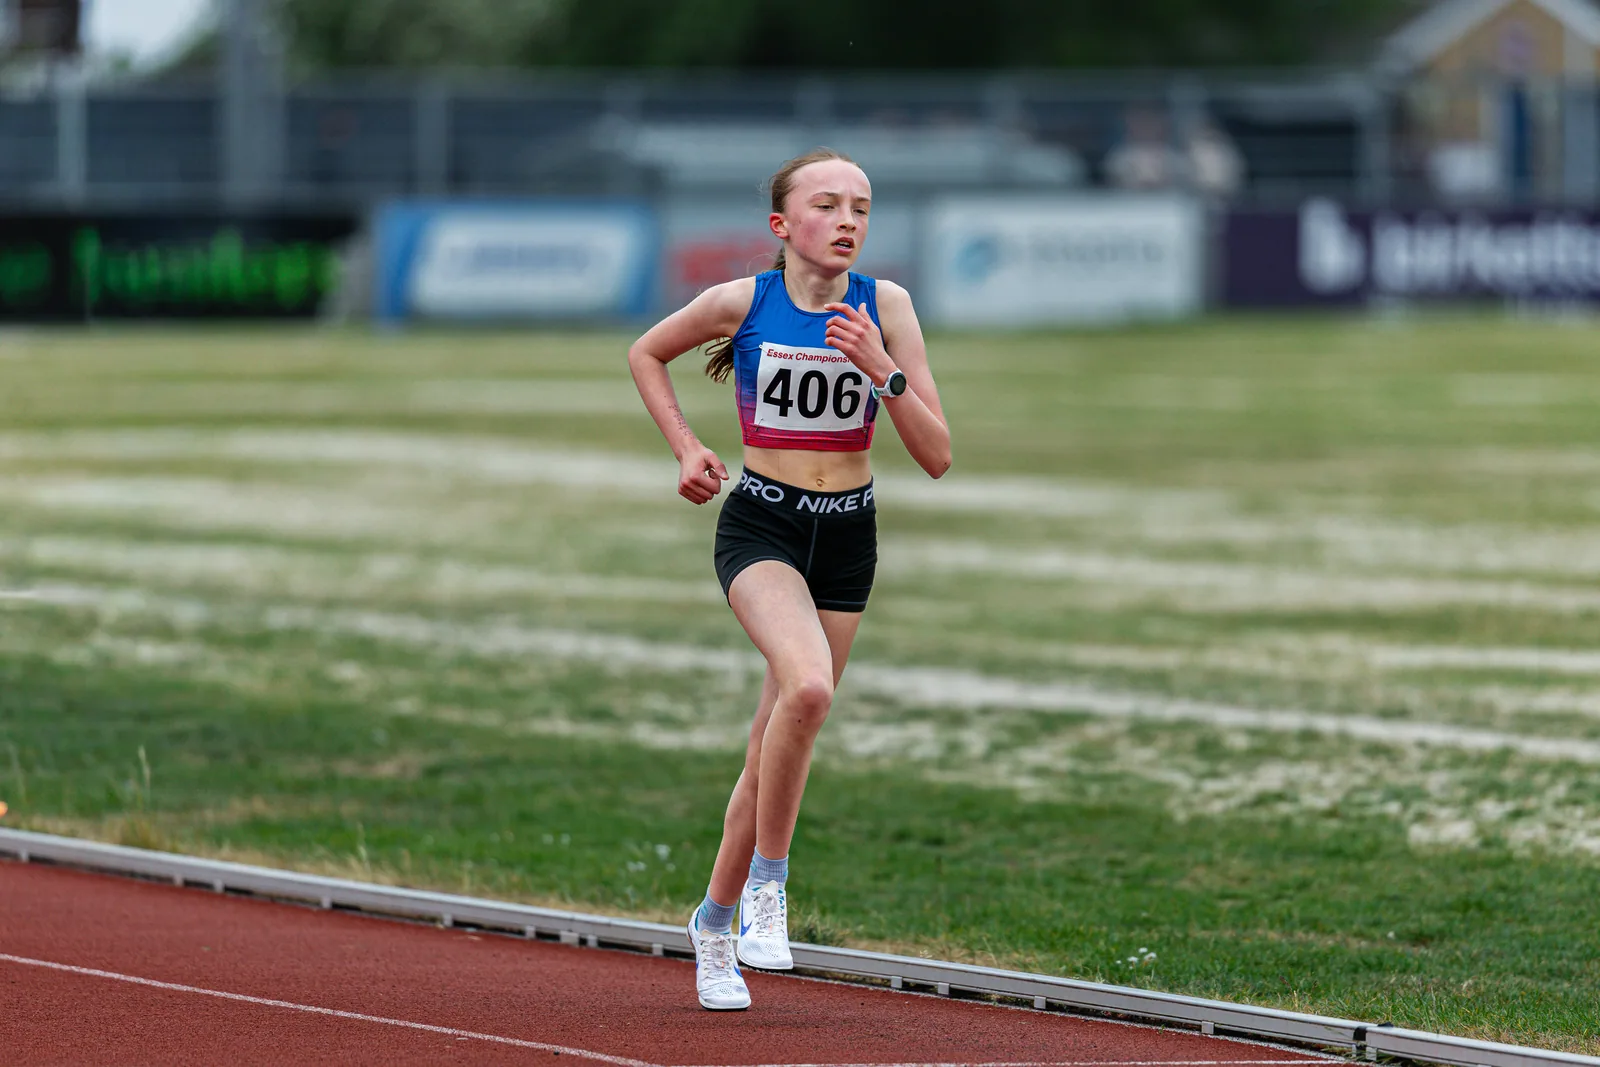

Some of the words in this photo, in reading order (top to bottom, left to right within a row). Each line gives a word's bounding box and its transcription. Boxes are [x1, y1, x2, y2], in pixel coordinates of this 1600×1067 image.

[766, 348, 794, 360] Essex
[762, 367, 863, 420] 406
[796, 493, 861, 514] NIKE
